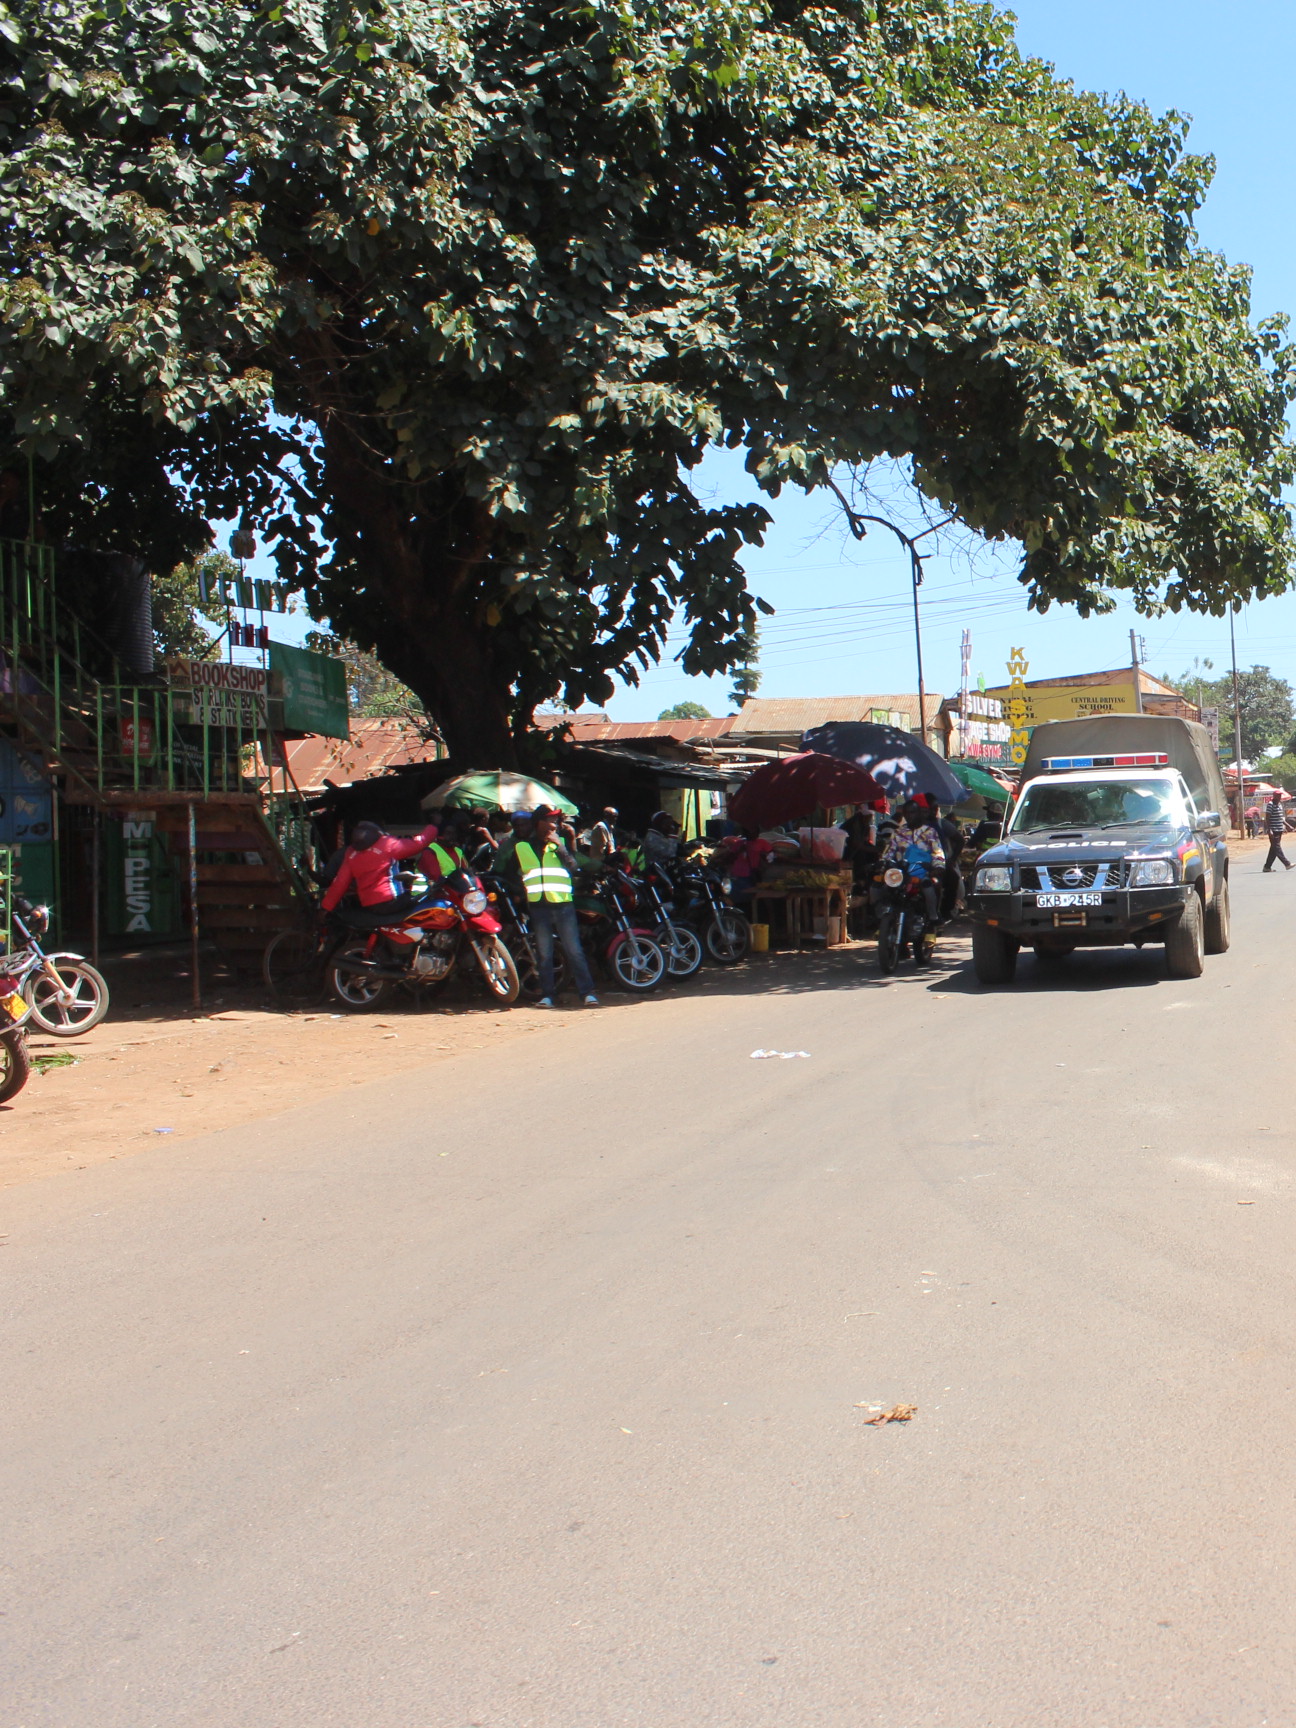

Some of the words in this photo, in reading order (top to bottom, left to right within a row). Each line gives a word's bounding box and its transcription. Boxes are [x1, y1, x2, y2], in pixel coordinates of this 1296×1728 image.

[200, 570, 289, 613] PENNY
[191, 662, 265, 690] BOOKSHOP
[1007, 647, 1029, 690] KWA
[966, 694, 1002, 718] SILVER
[1029, 841, 1127, 850] POLICE
